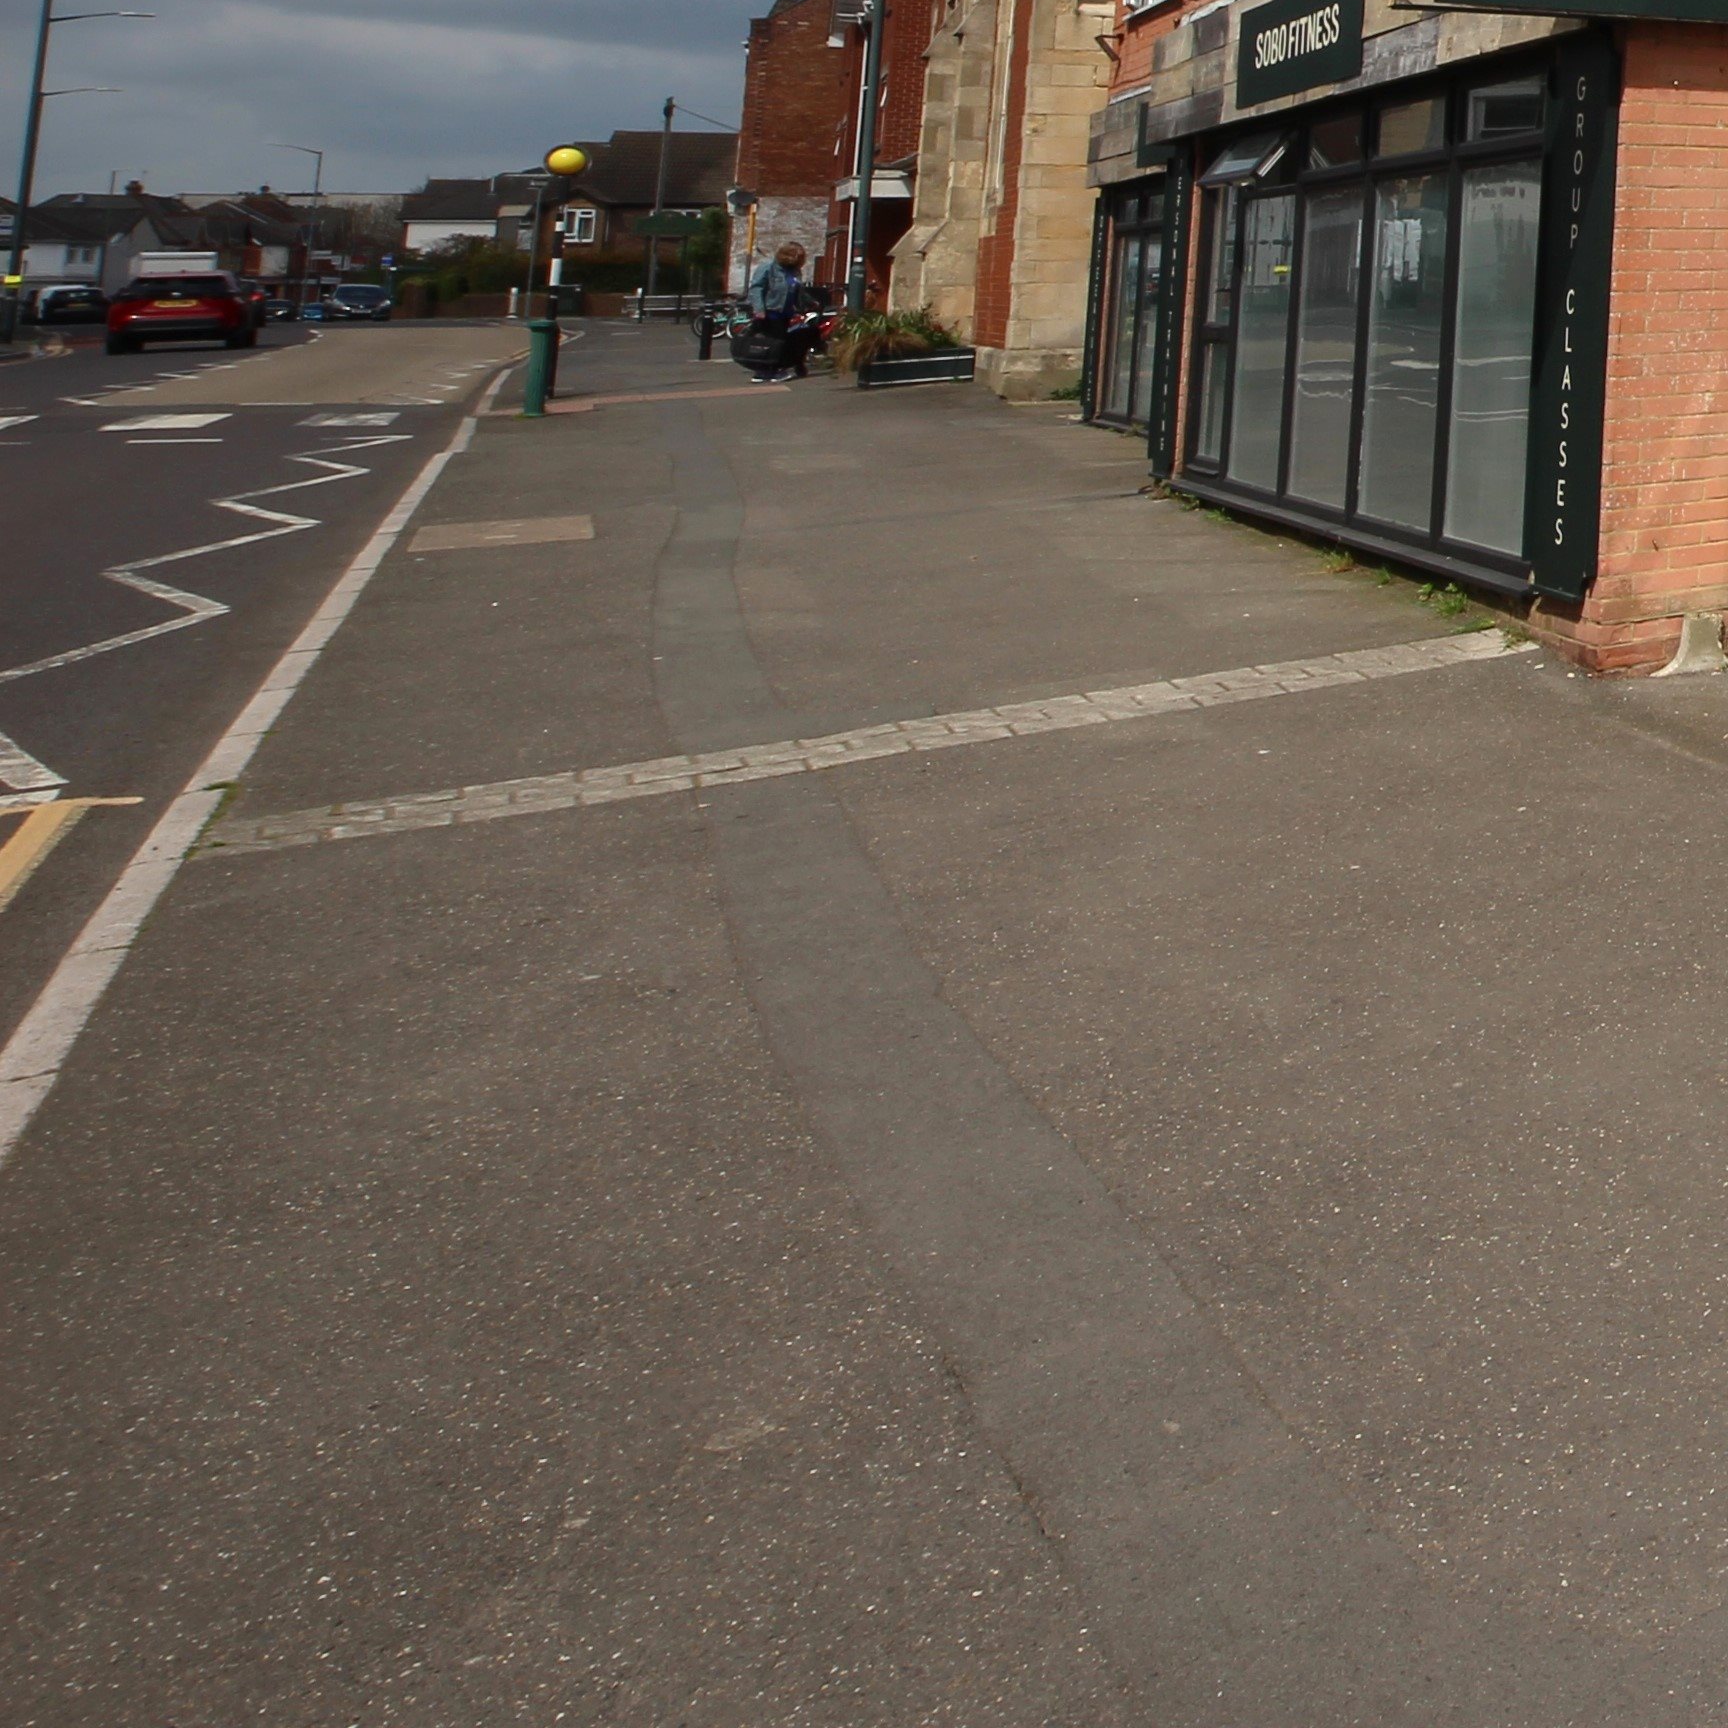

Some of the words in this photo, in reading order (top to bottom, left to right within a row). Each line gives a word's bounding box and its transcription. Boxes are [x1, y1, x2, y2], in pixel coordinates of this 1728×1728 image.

[1255, 23, 1287, 69] SOBO
[1287, 3, 1340, 59] FITNESS
[1569, 76, 1587, 249] GROUP
[1553, 289, 1576, 546] CLASSES
